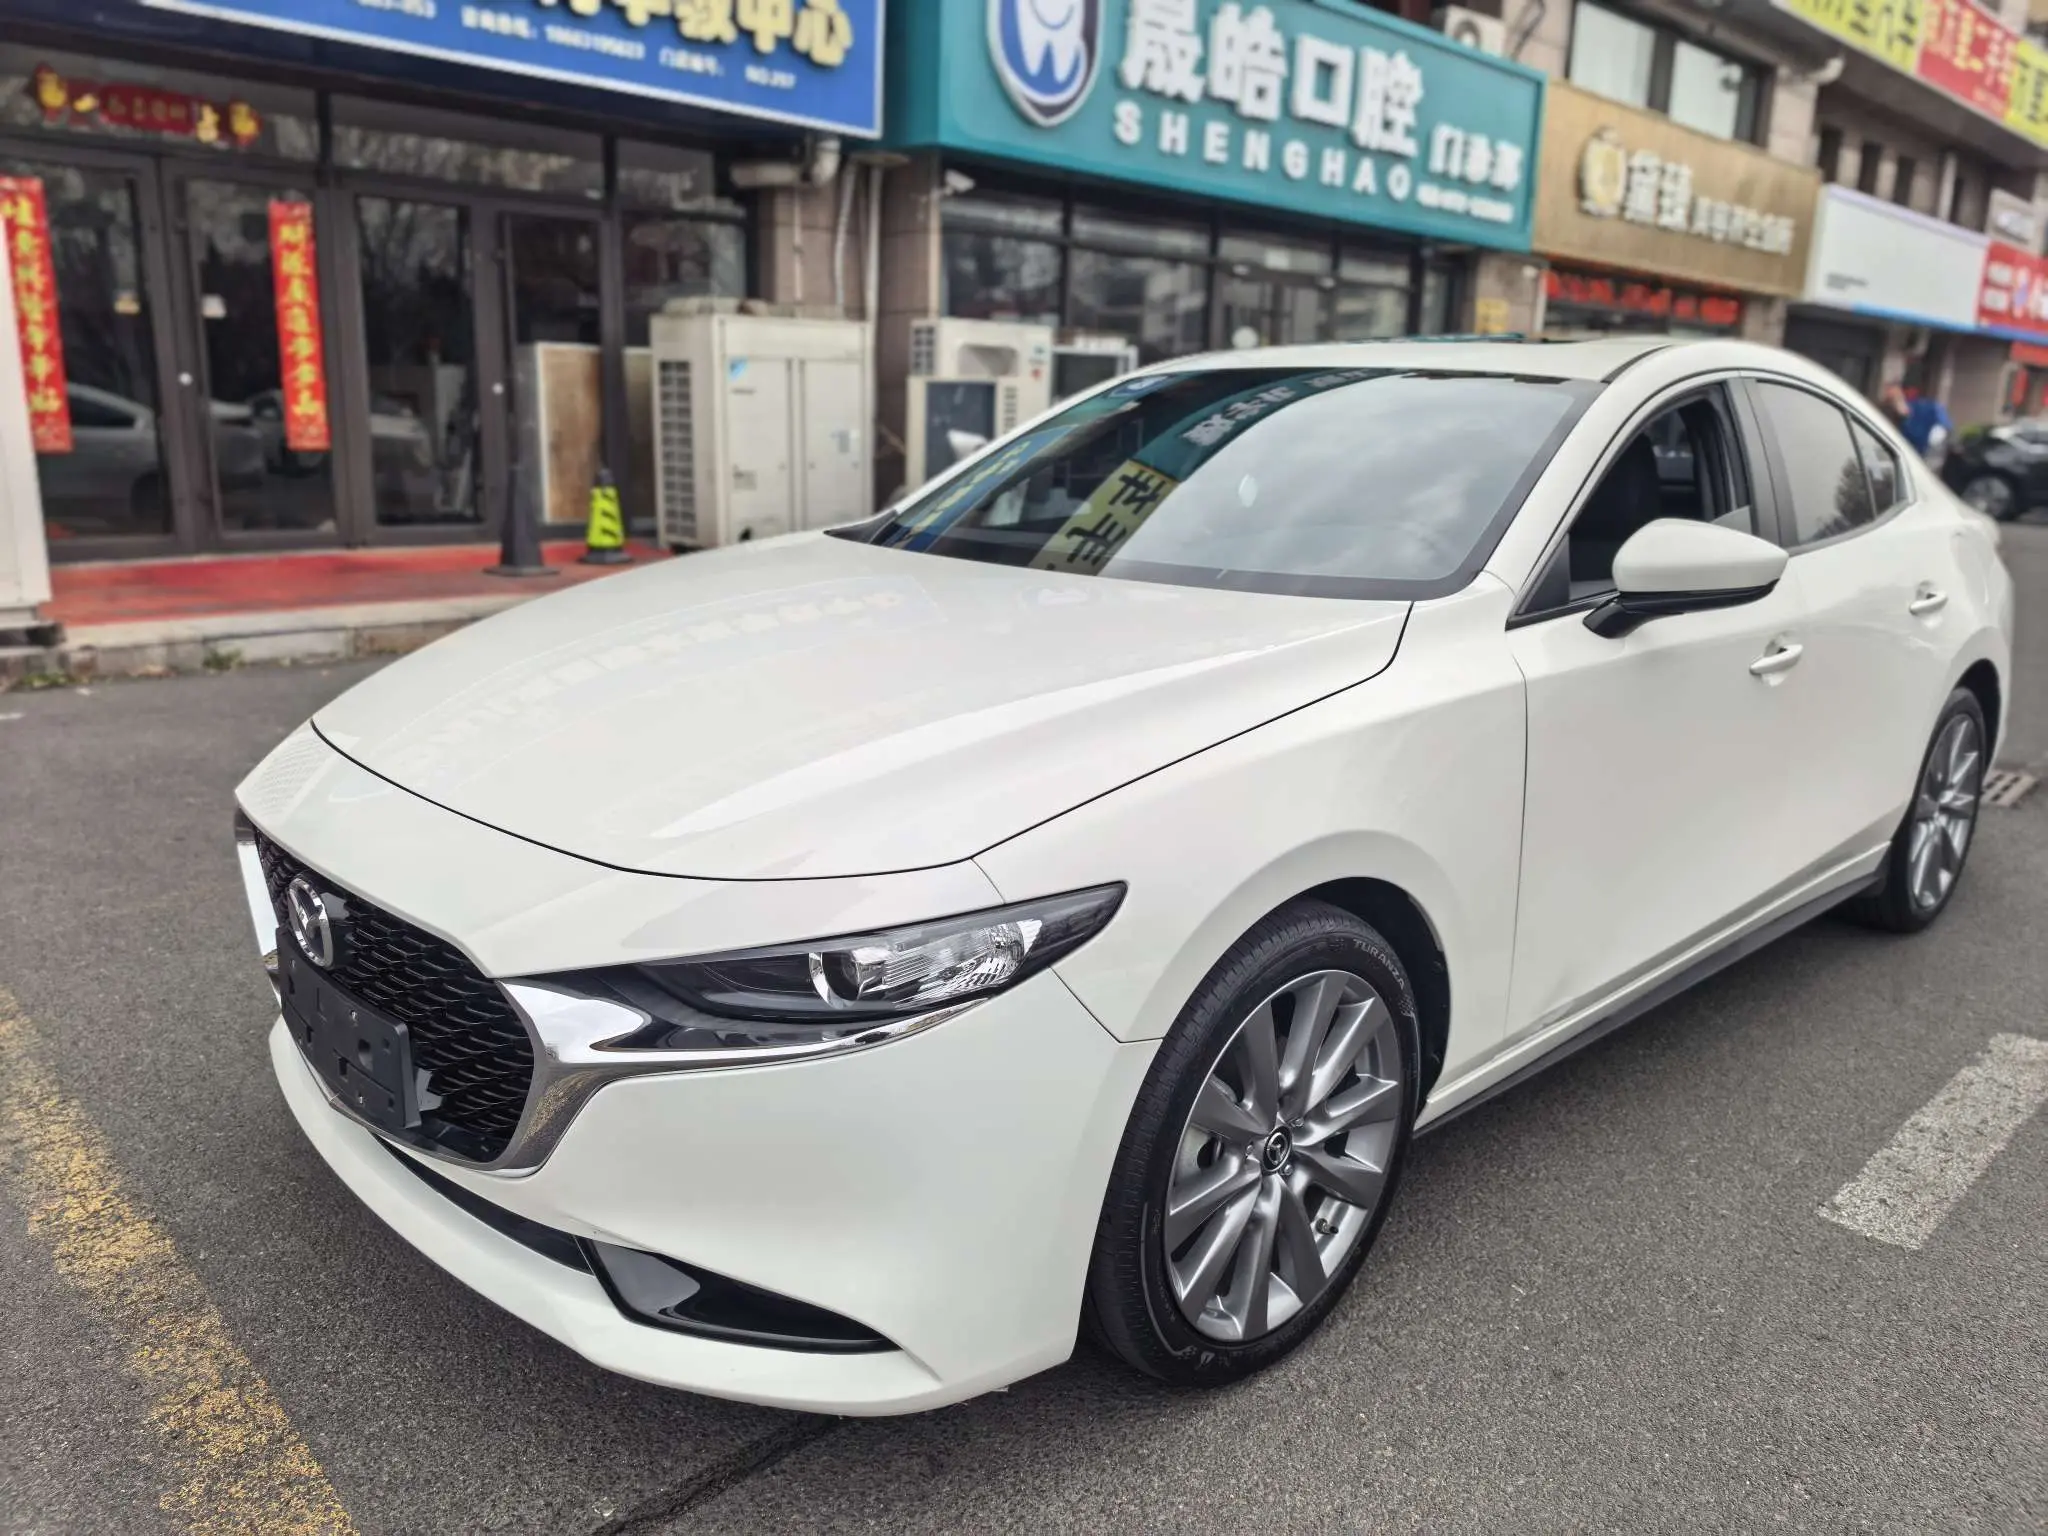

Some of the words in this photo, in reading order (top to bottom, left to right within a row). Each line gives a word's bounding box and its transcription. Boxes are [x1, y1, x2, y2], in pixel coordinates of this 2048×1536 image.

[1120, 0, 1423, 158] 晟皓口腔
[1114, 100, 1412, 200] SHENGHAO
[1353, 938, 1405, 990] TURANZA
